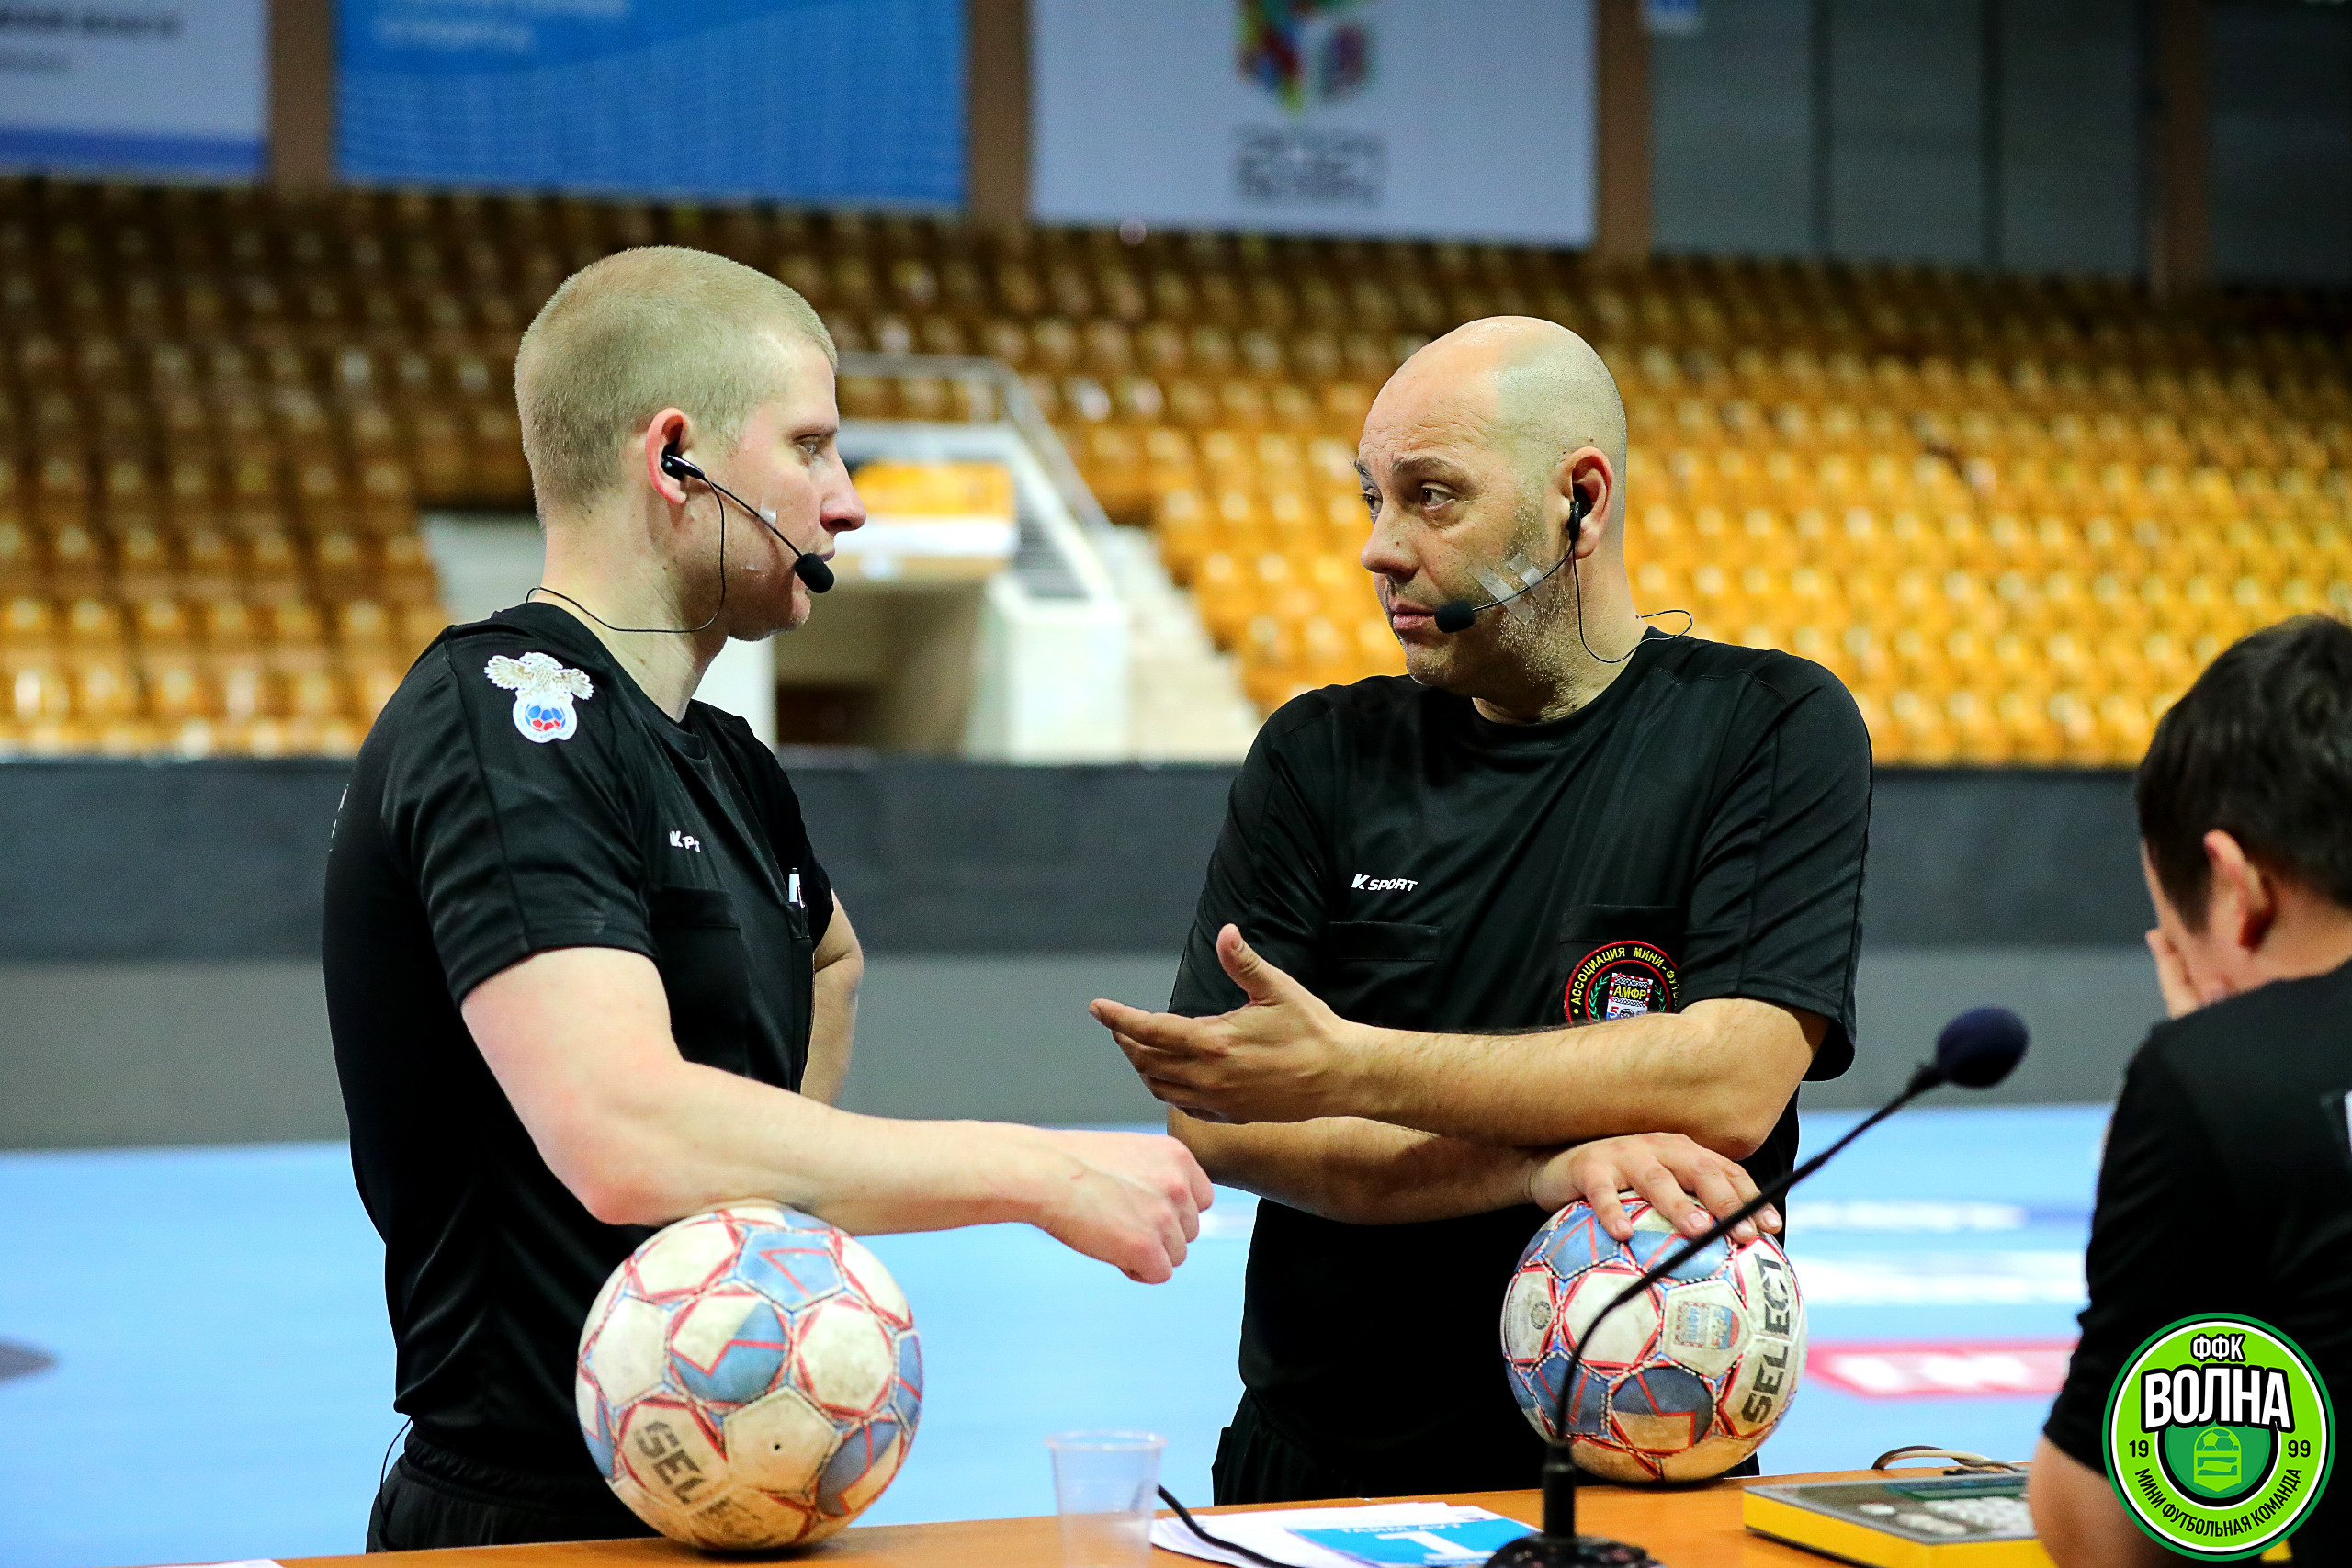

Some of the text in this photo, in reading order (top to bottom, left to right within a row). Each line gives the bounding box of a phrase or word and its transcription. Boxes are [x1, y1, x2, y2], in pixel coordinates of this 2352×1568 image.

[1351, 874, 1418, 891] K SPORT
[1571, 947, 1679, 1007] АССОЦИАЦИЯ МИНИ-ФУТ
[1613, 985, 1646, 999] АМФР
[1741, 1253, 1791, 1423] SELECT
[634, 1420, 763, 1529] SELE
